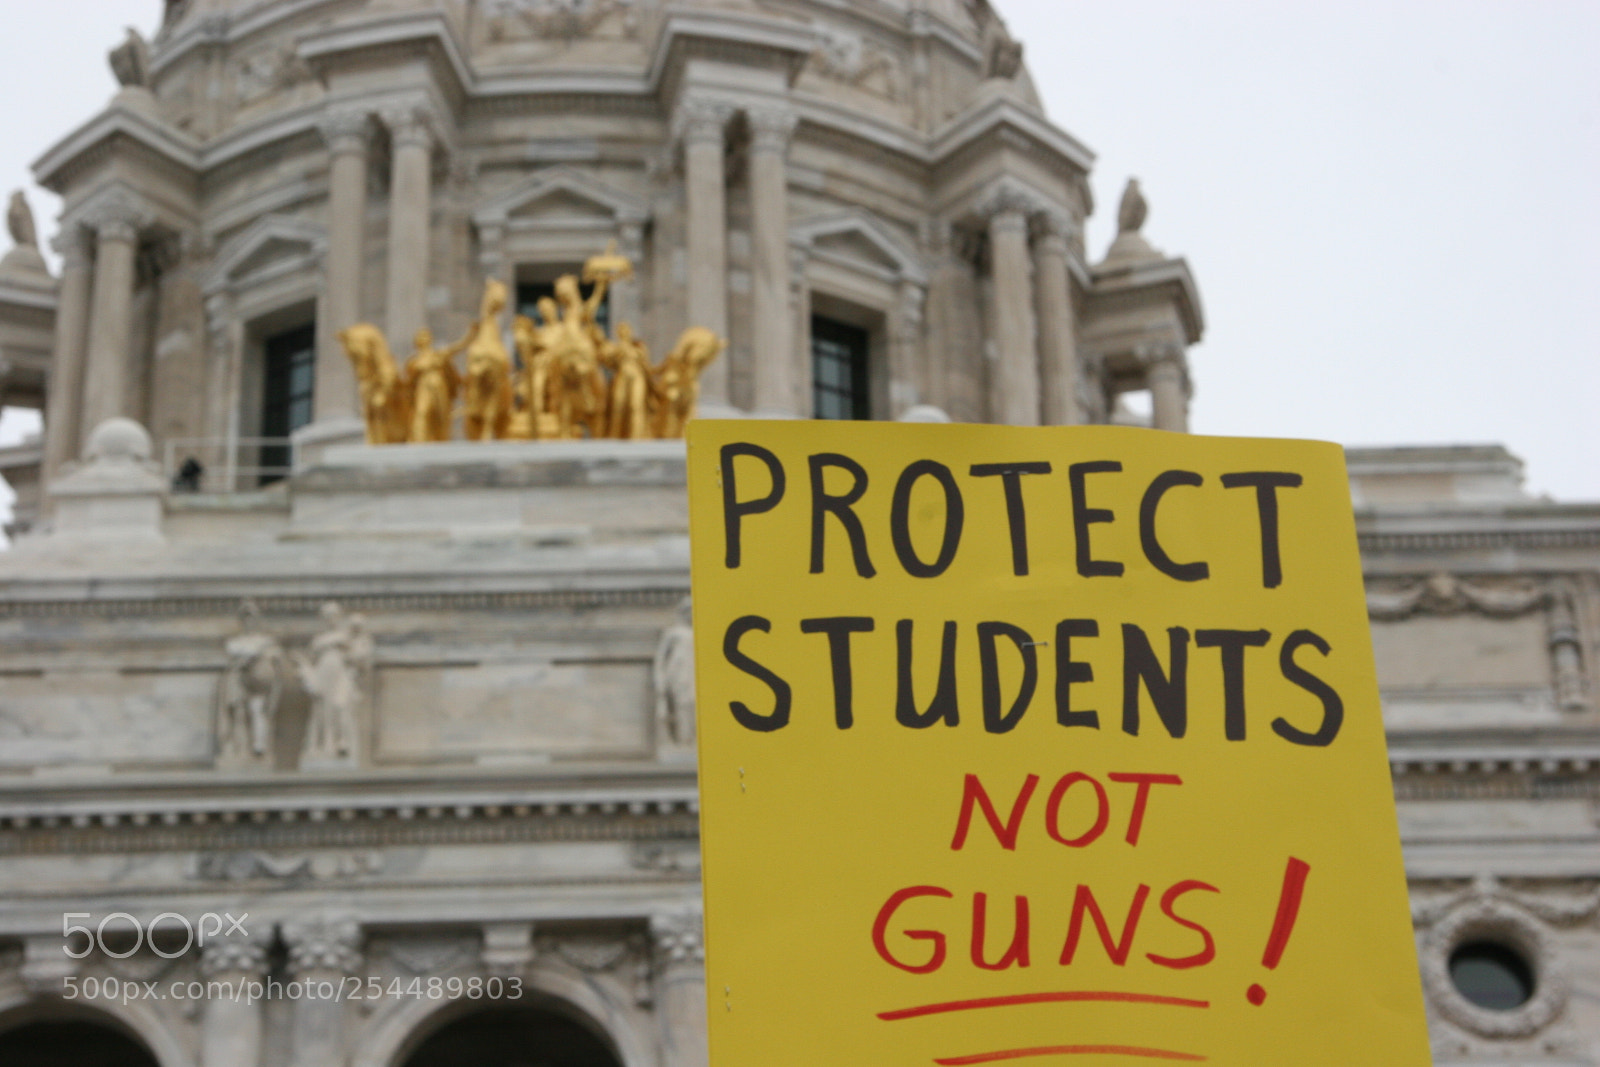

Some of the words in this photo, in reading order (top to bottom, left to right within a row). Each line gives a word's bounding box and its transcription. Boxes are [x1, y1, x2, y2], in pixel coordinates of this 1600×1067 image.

[720, 443, 1302, 588] PROTECT
[723, 615, 1343, 746] STUDENTS
[951, 772, 1182, 850] NOT
